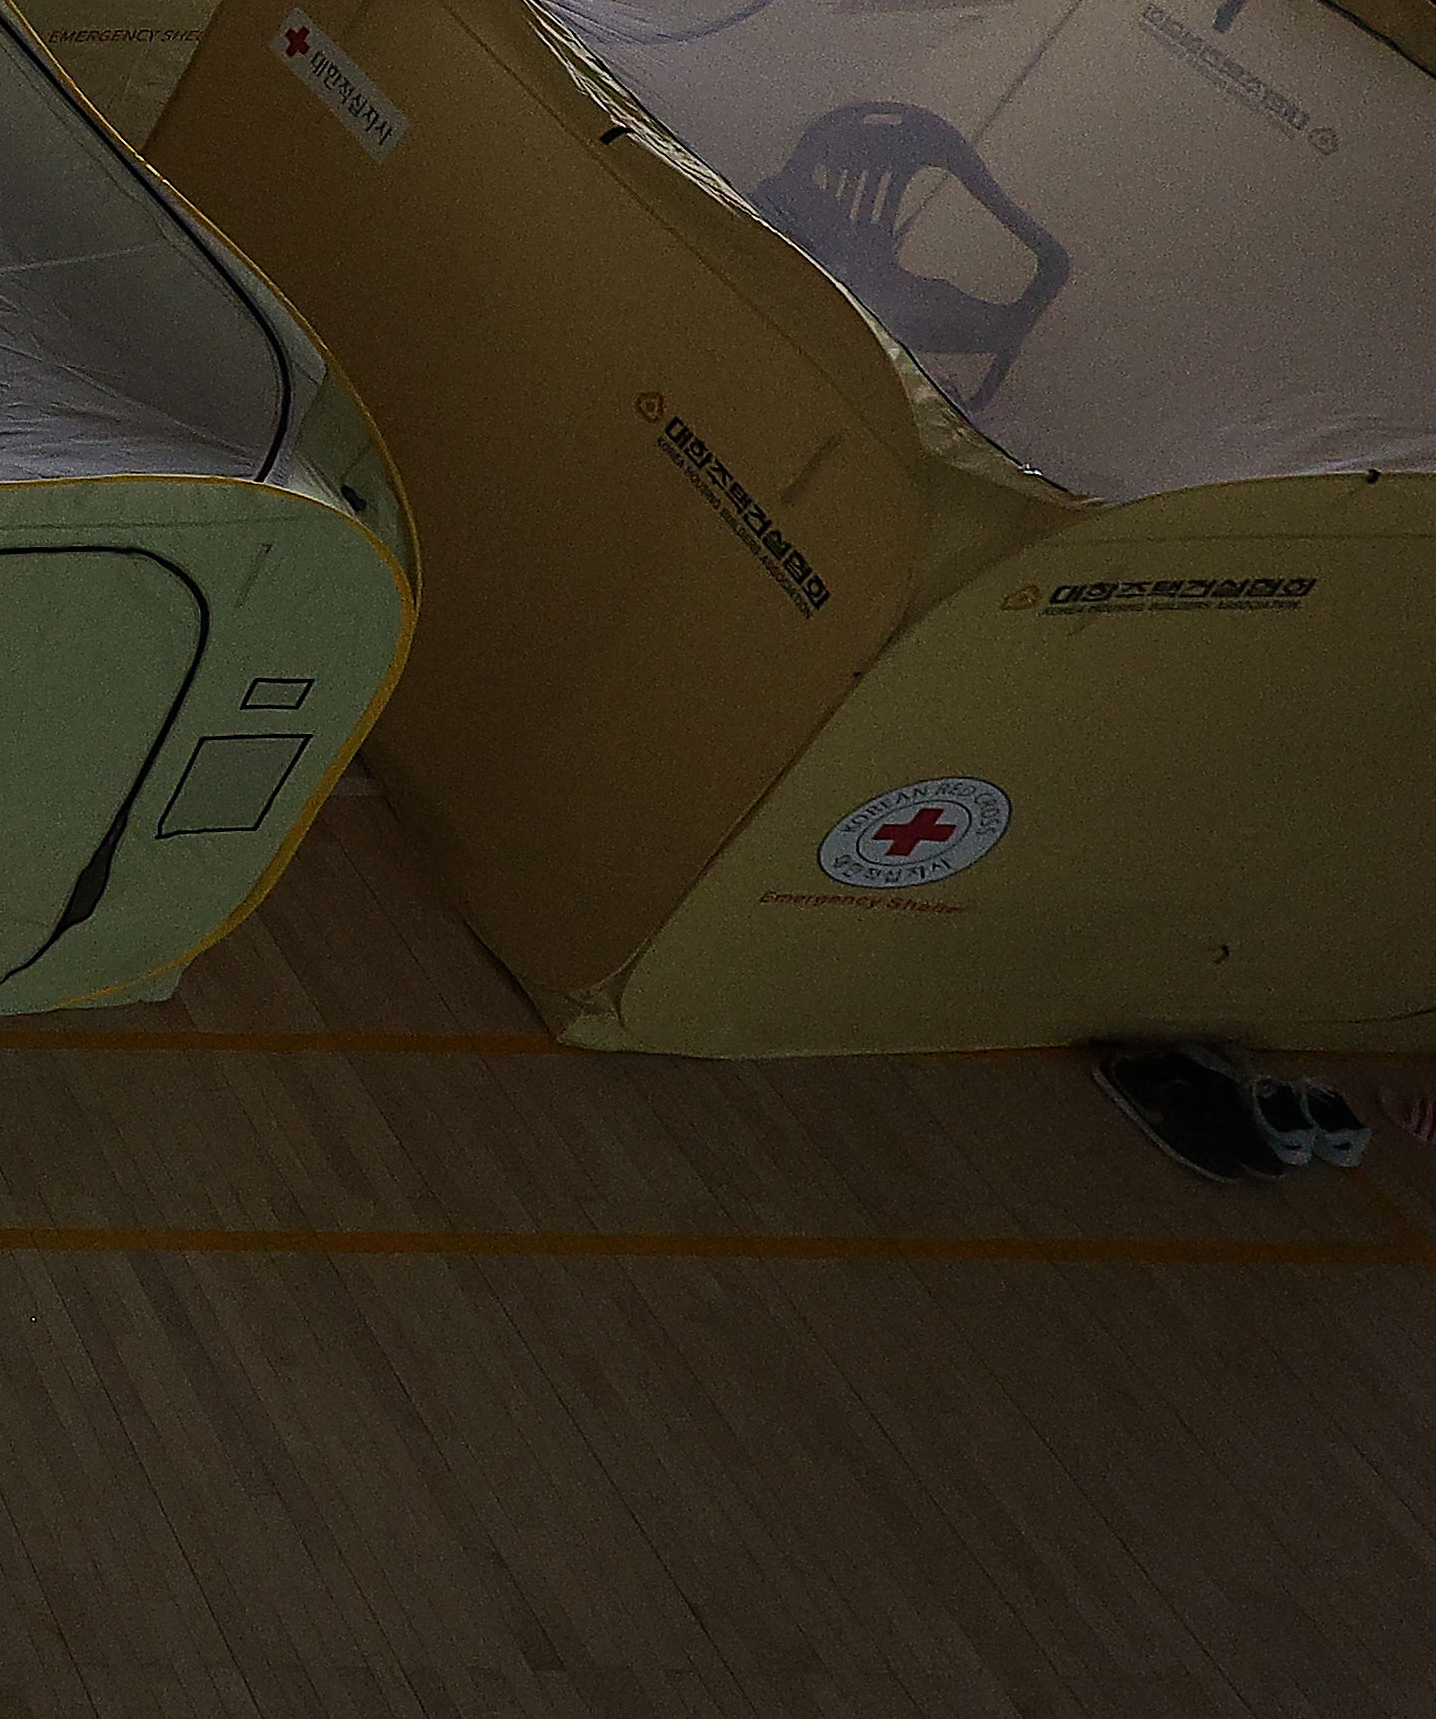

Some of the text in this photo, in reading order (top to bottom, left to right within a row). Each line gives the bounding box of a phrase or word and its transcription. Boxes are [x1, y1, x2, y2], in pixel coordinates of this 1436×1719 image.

[48, 30, 159, 44] EMERGENCY
[310, 48, 394, 146] 대한적십자사
[665, 415, 831, 610] 대한주택건설협회
